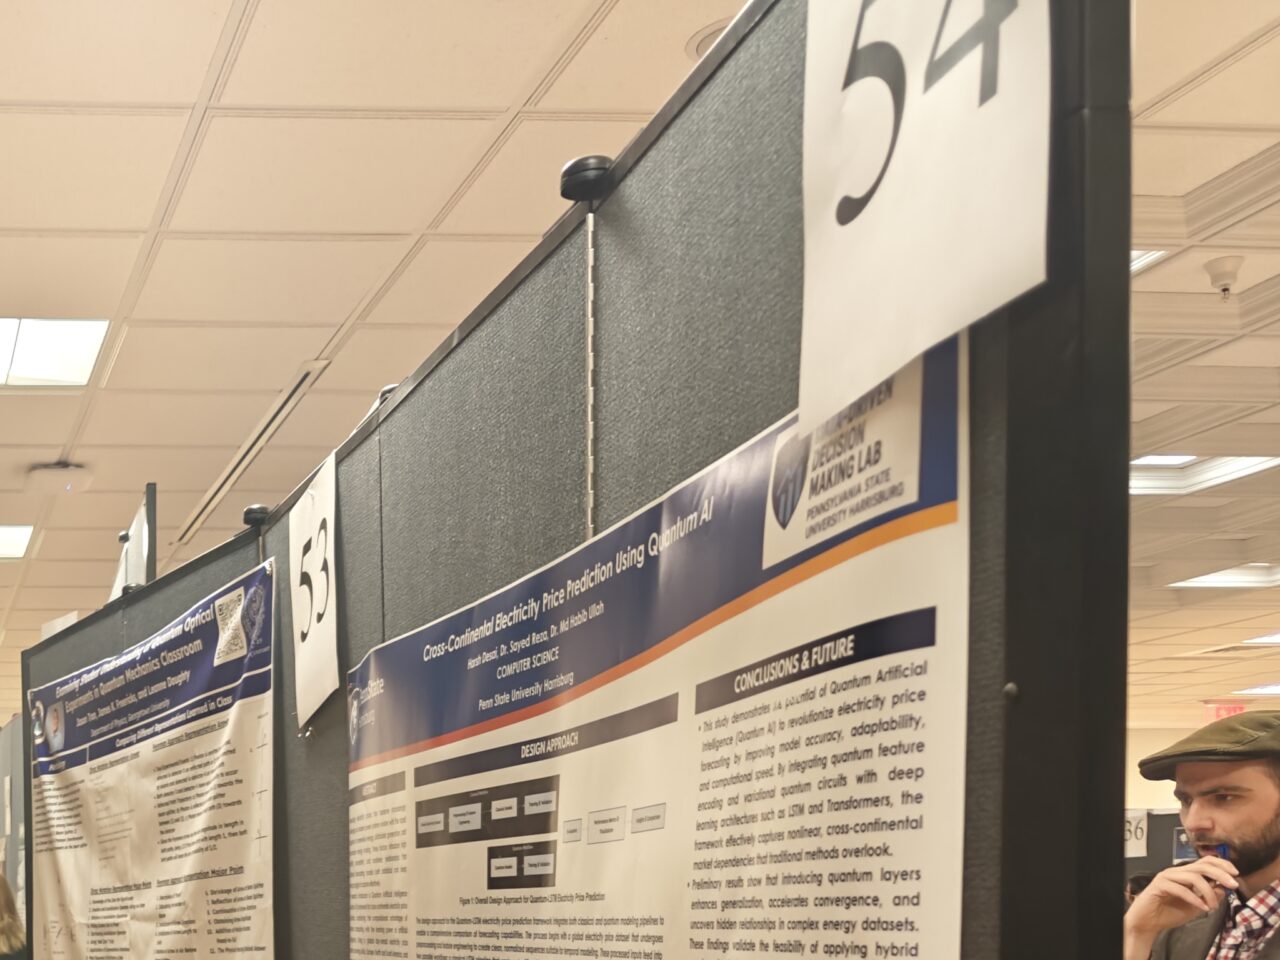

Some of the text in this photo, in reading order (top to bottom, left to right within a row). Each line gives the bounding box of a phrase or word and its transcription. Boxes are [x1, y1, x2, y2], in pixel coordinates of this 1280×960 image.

[836, 0, 1018, 226] 54
[812, 420, 865, 472] DECISION
[808, 440, 882, 500] MAKING LAB
[806, 467, 891, 521] PENNSYLVANIA STATE
[805, 509, 847, 539] UNIVERSITY
[299, 517, 329, 643] 53
[423, 496, 714, 663] Cross-Continental Electricity Price Prediction Using Quantum AI
[184, 604, 214, 633] Optical
[500, 641, 508, 656] Dr.
[509, 632, 530, 654] Sayed
[532, 626, 548, 646] Reza,
[550, 623, 559, 638] Dr.
[125, 657, 160, 682] Mechanics
[160, 638, 203, 666] Classroom
[496, 646, 560, 680] COMPUTER SCIENCE
[734, 634, 855, 693] CONCLUSIONS & FUTURE
[478, 671, 574, 712] Penn State University Harrisburg
[731, 660, 928, 724] demonstrates Quantum Artificial
[787, 706, 834, 728] revolutionize
[838, 694, 885, 716] electricity
[891, 688, 927, 708] price
[521, 732, 579, 759] DESIGN APPROACH
[745, 714, 926, 762] improving model adaptability,
[788, 740, 925, 774] integrating quantum feature
[781, 765, 925, 798] quantum circuits with deep
[808, 790, 924, 815] and Transformers, the
[826, 815, 923, 836] cross-continental
[769, 842, 893, 864] traditional methods overlook.
[782, 867, 922, 886] introducing quantum layers
[814, 892, 921, 910] convergence, and
[716, 916, 919, 934] hidden complex energy datasets.
[773, 939, 919, 960] feasibility applying hybrid
